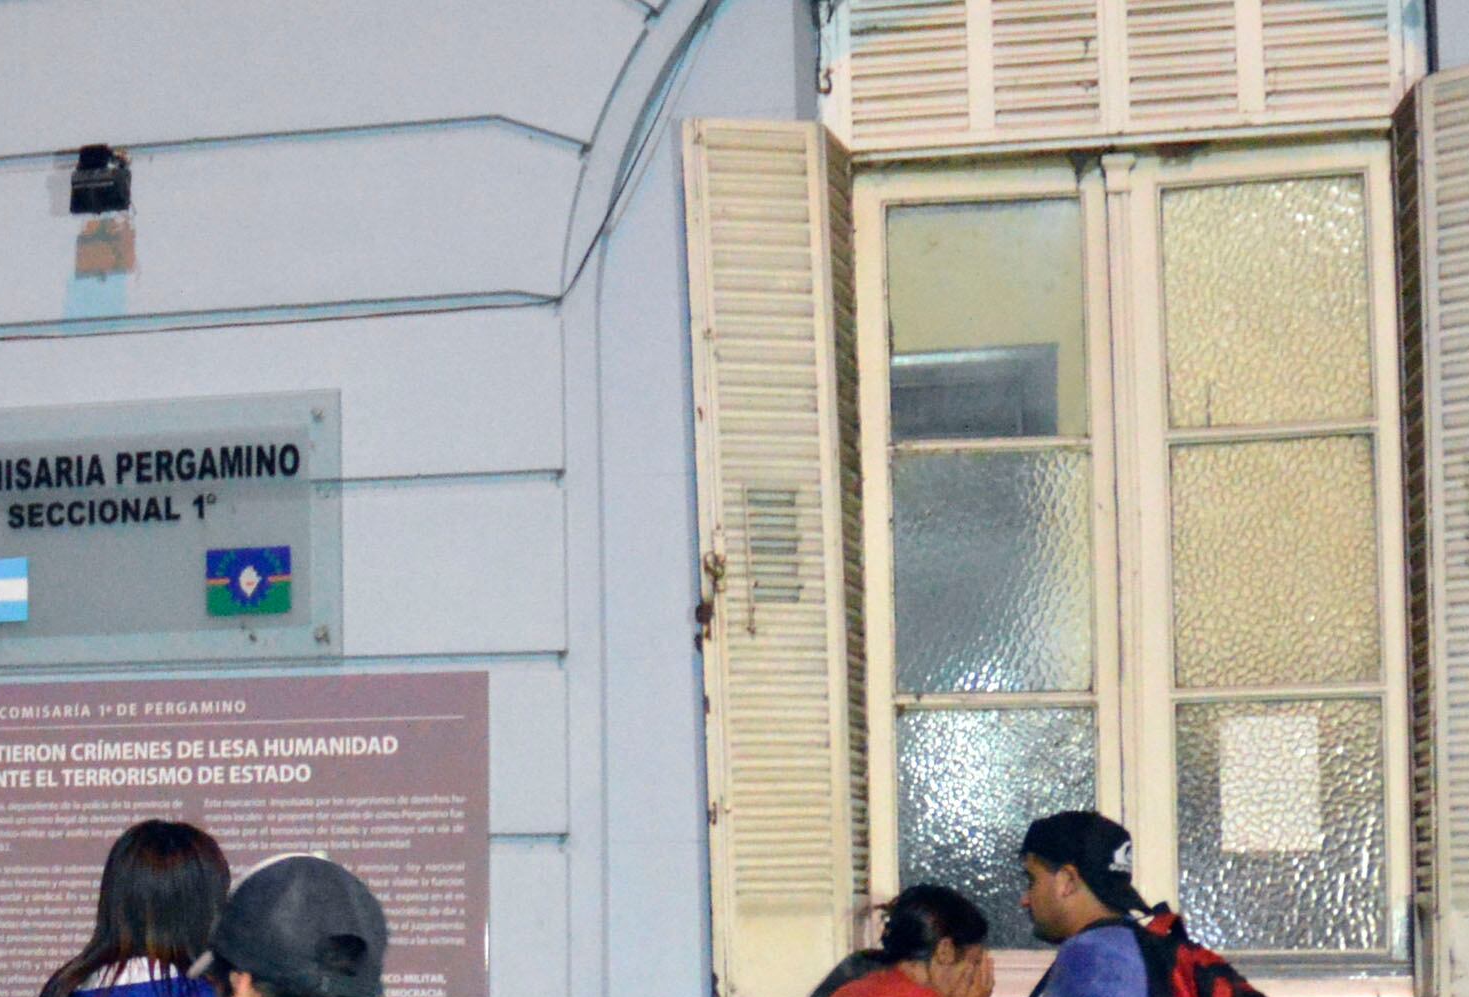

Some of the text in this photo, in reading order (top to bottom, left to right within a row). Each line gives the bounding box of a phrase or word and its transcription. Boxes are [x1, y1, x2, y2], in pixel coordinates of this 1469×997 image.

[115, 443, 300, 486] PERGAMINO
[8, 496, 181, 529] SECCIONAL
[117, 703, 137, 717] DE
[145, 700, 247, 716] PERGAMINO
[71, 739, 172, 761] CRÍMENES
[177, 741, 203, 759] DE
[209, 739, 259, 758] LESA
[264, 736, 399, 757] HUMANIDAD
[36, 769, 54, 788] EL
[61, 767, 192, 787] TERRORISMO
[198, 766, 225, 784] DE
[229, 764, 312, 784] ESTADO
